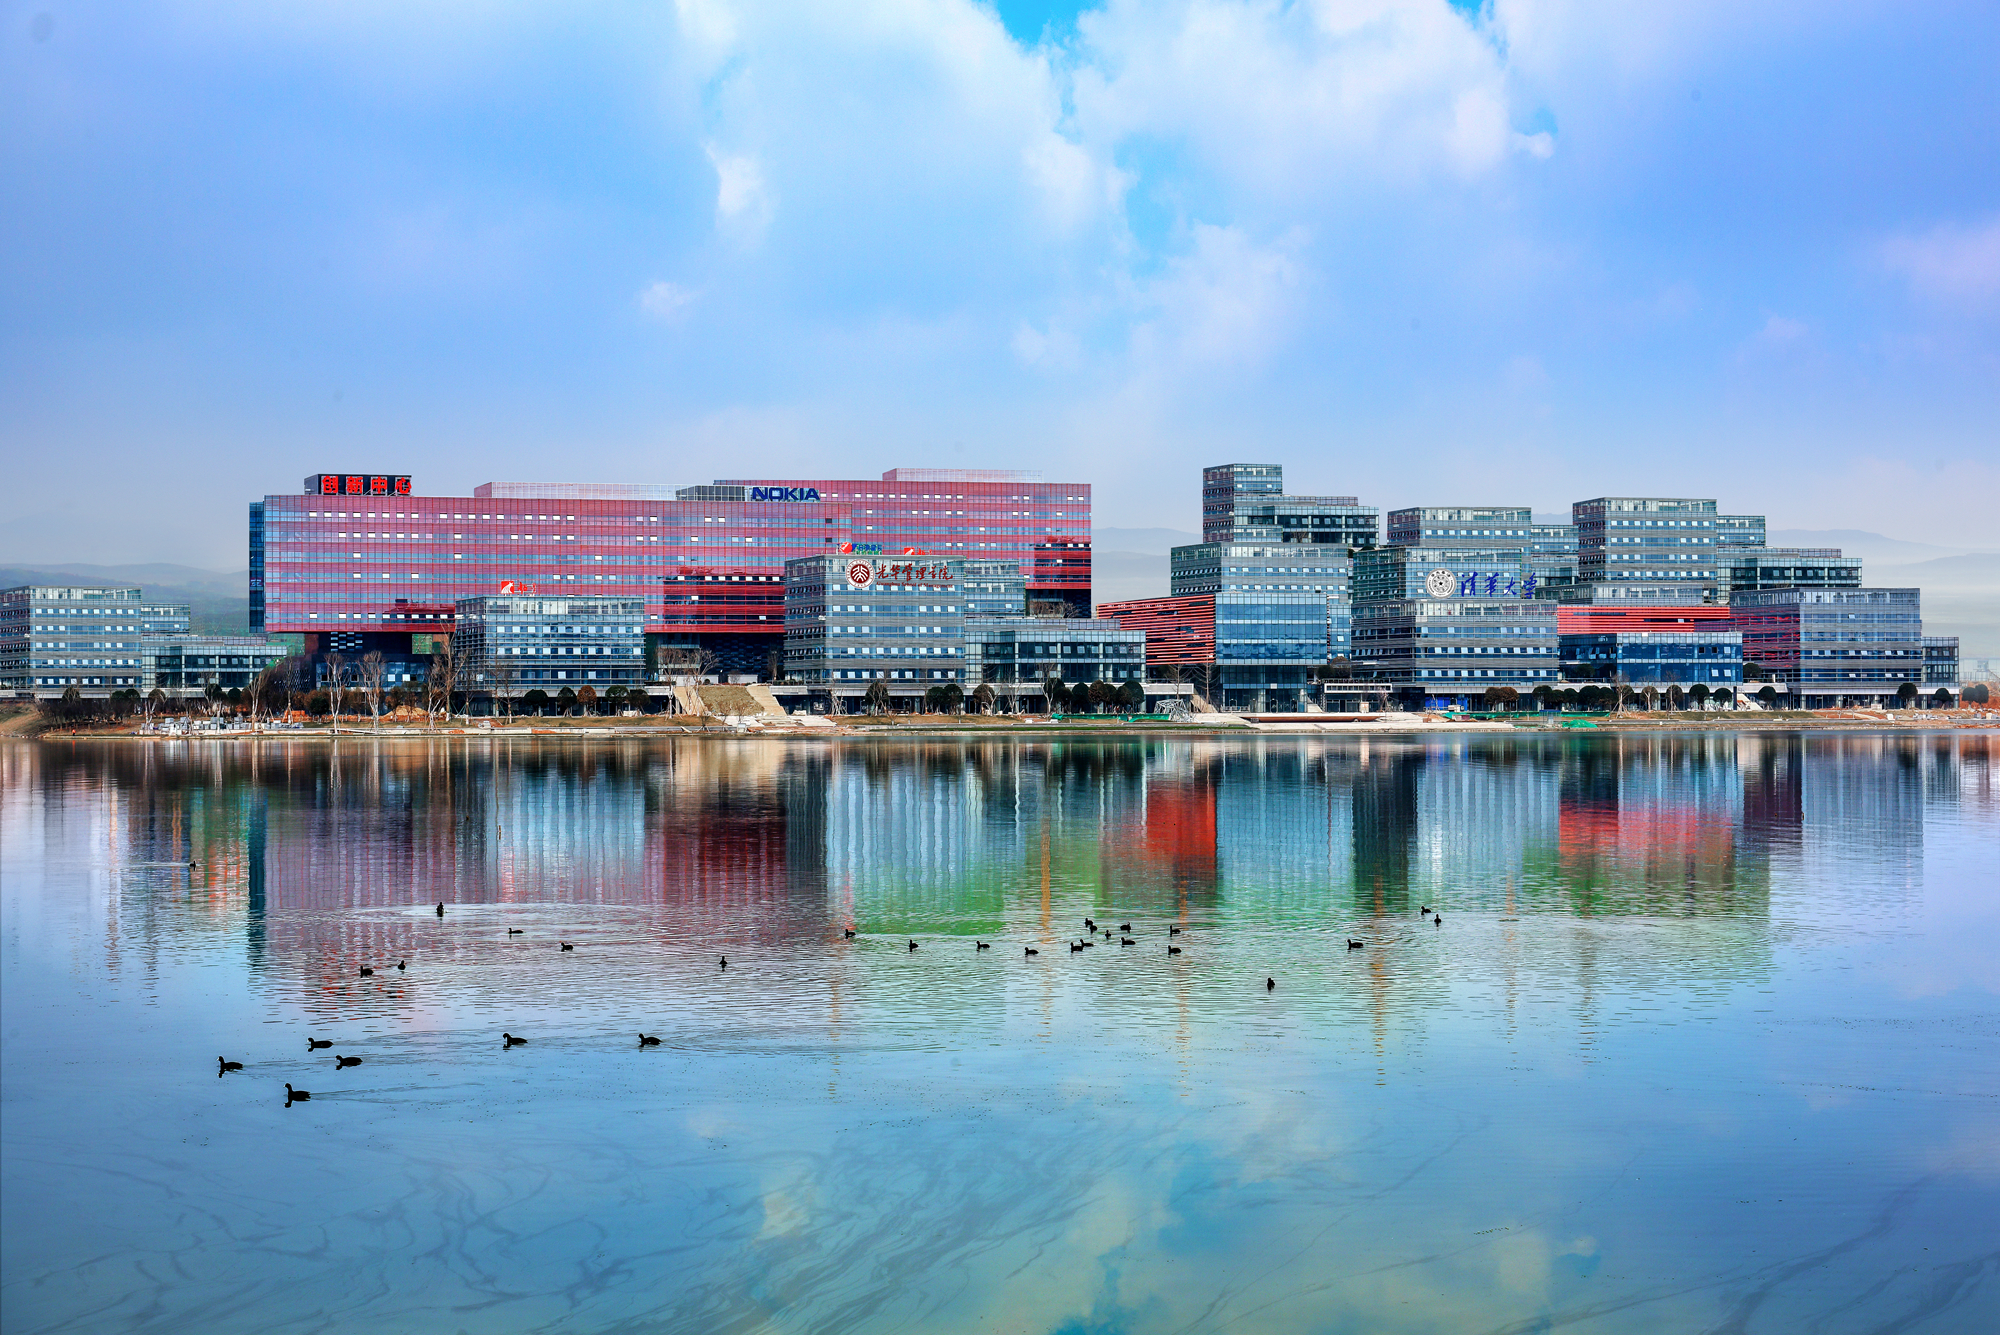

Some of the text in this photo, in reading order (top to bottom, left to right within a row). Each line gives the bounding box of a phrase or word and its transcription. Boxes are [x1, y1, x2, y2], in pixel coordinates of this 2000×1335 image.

[322, 475, 412, 494] 创新中心
[752, 487, 820, 501] NOKIA
